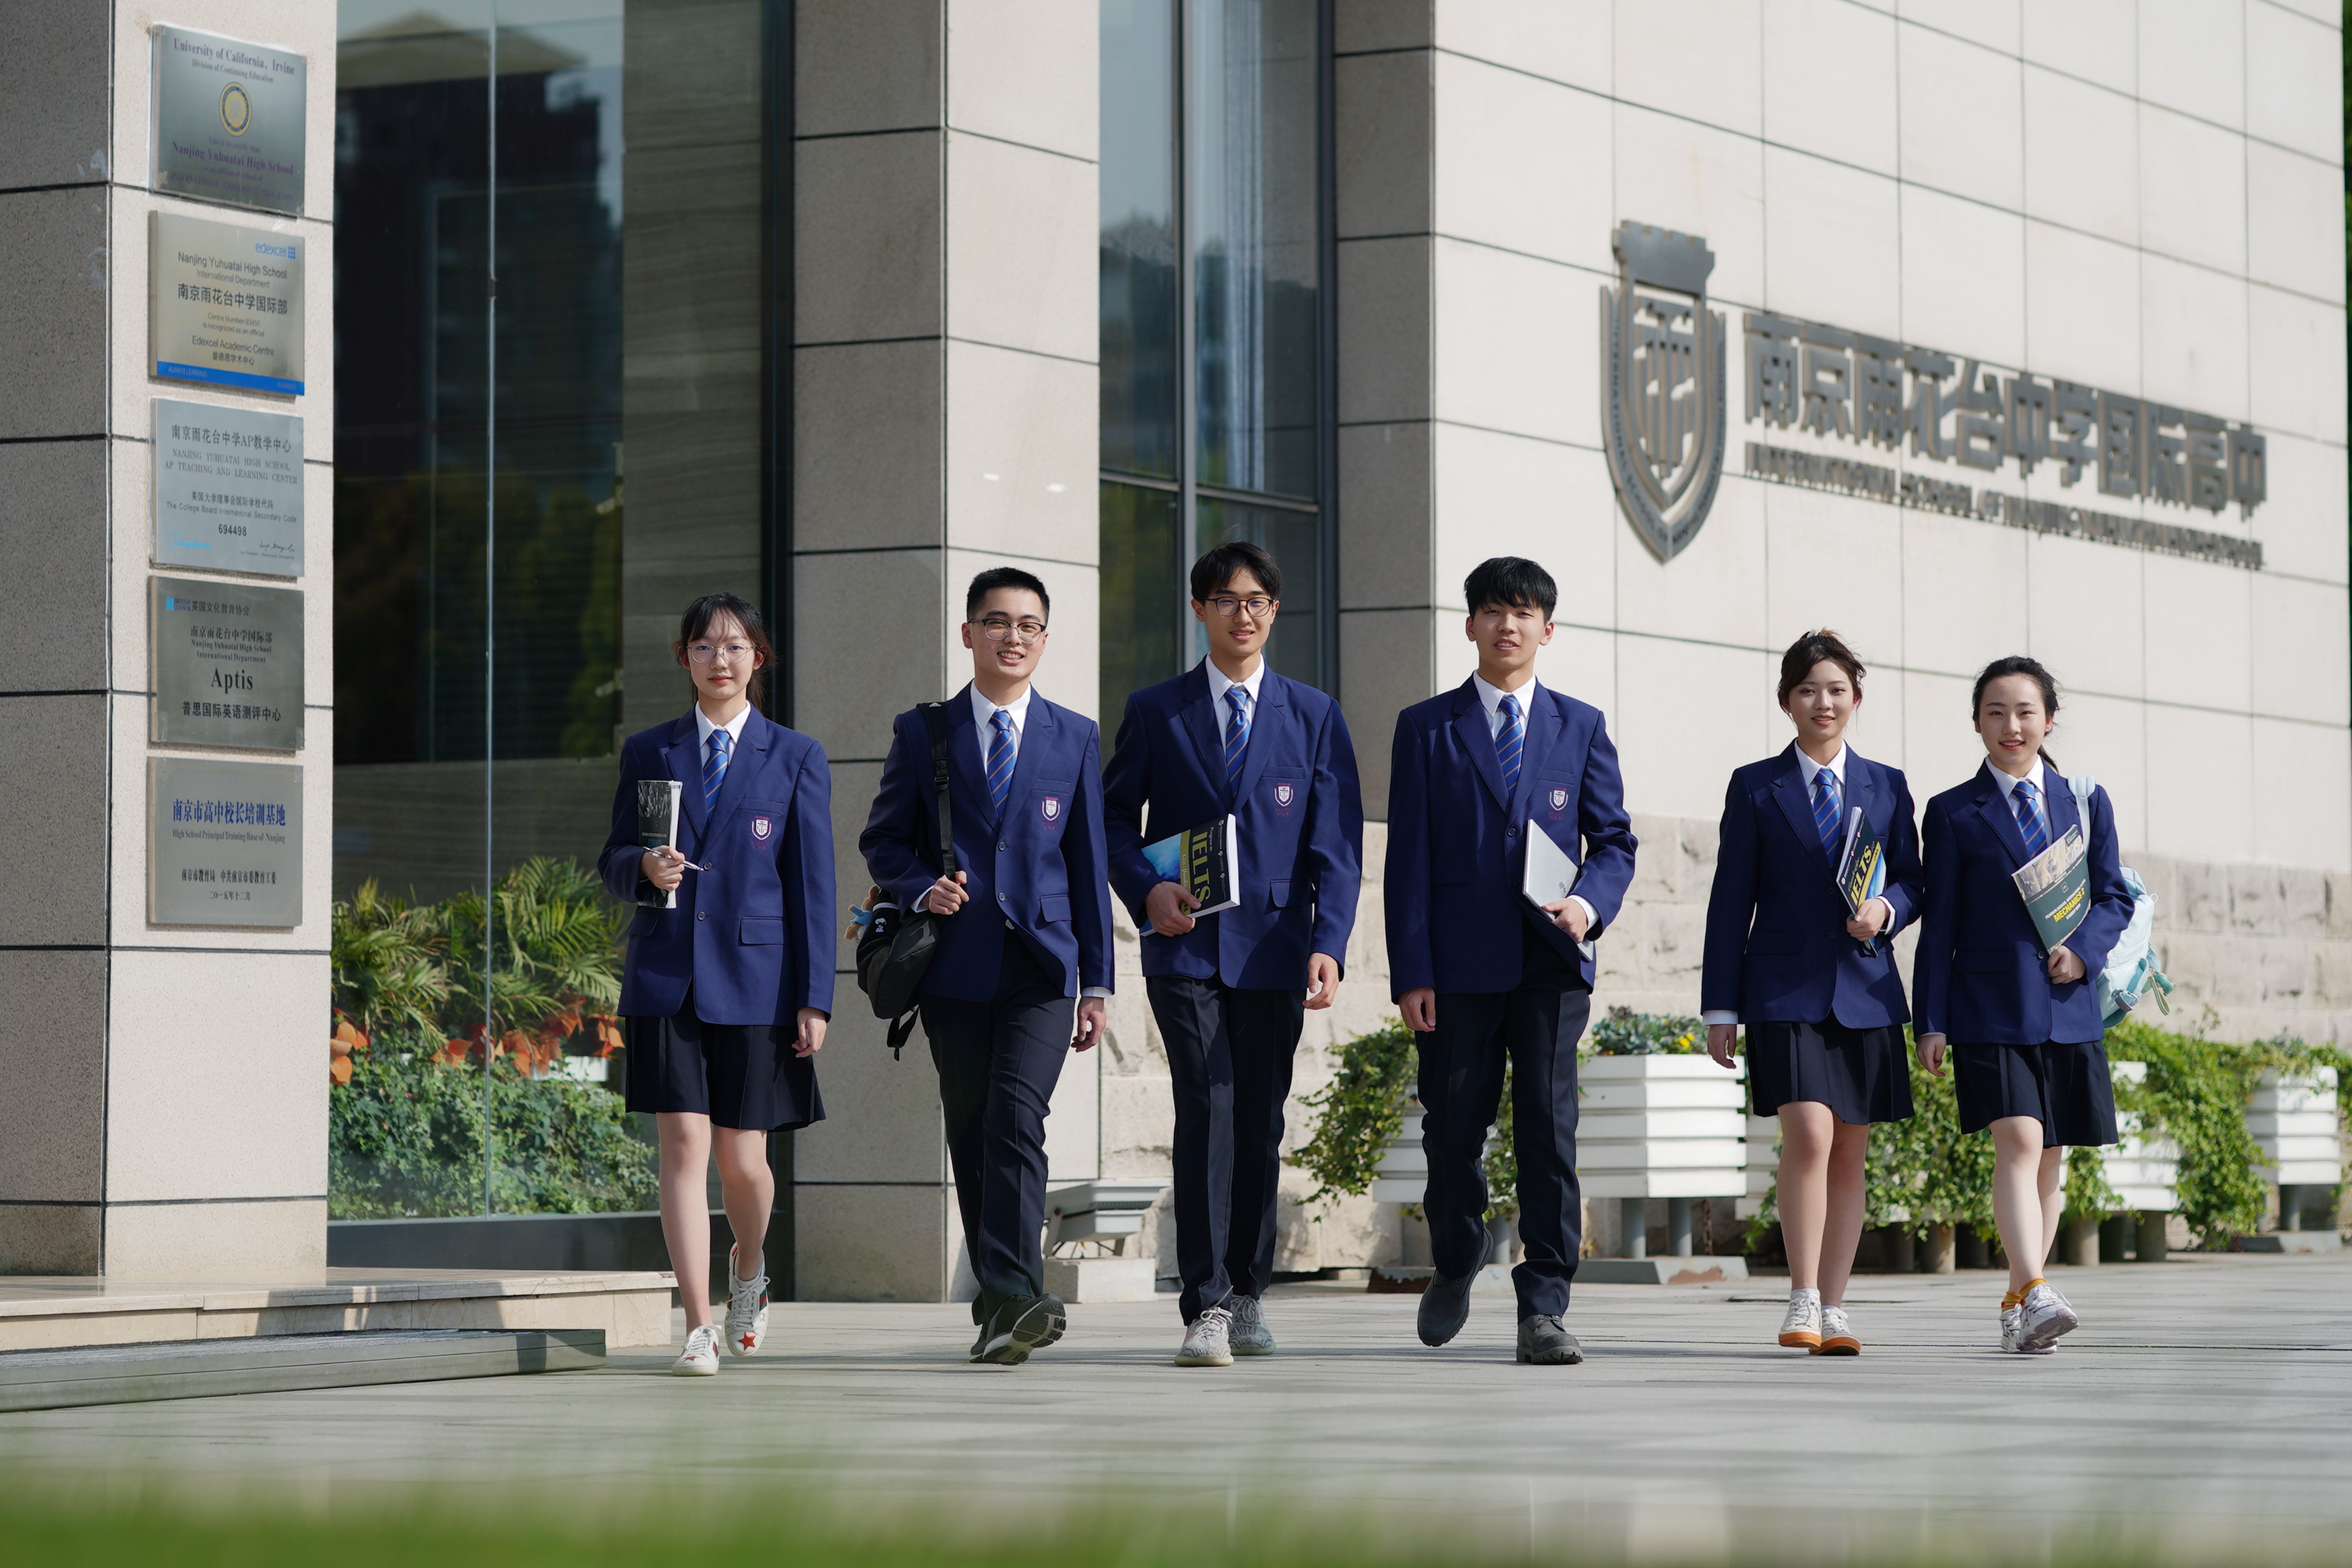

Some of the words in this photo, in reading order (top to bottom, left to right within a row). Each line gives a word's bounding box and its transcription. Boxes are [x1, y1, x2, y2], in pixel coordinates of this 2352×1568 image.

[174, 38, 213, 60] University
[216, 48, 224, 59] of
[272, 60, 295, 75] Irvine
[192, 59, 212, 71] Division
[213, 63, 219, 72] of
[220, 65, 248, 79] Continuing
[249, 71, 274, 84] Education
[173, 141, 205, 160] Nanjing
[209, 148, 244, 166] Yuhuatai
[247, 155, 265, 171] High
[268, 160, 293, 176] School
[255, 243, 287, 257] edexcel
[178, 251, 207, 268] Nanjing
[209, 256, 243, 271] Yuhuatai
[244, 262, 261, 277] High
[262, 265, 287, 280] School
[197, 268, 234, 283] International
[235, 275, 270, 289] Department
[178, 283, 287, 316] 南京雨花台中学国际部
[207, 312, 224, 322] Centre
[192, 335, 218, 348] Edexcel
[220, 339, 252, 353] Academic
[253, 345, 275, 357] Centre
[171, 424, 291, 453] 南京雨花台中学AP教学中心
[172, 448, 202, 460] NANJING
[206, 452, 240, 466] YUHUATAI
[244, 457, 261, 468] HIGH
[265, 460, 290, 471] SCHOOL
[164, 461, 174, 469] AP
[177, 462, 212, 474] TEACHING
[216, 467, 230, 476] AND
[235, 468, 268, 481] LEARNING
[272, 473, 298, 485] CENTER
[1745, 442, 1895, 504] INTERNATIONAL
[1901, 471, 1973, 519] SCHOOL
[167, 501, 176, 510] The
[179, 503, 199, 513] College
[201, 505, 217, 514] Board
[219, 509, 252, 517] International
[254, 510, 281, 522] Secondary
[283, 514, 297, 523] Code
[218, 523, 247, 537] 694498
[191, 601, 250, 616] 英国文化教育协会
[191, 625, 272, 644] 南京雨花台中学国际部
[191, 639, 213, 650] Nanjing
[214, 642, 238, 650] Yuhuatai
[239, 643, 252, 653] High
[253, 644, 271, 653] School
[197, 650, 232, 660] International
[234, 653, 266, 664] Department
[211, 667, 253, 694] Aptis
[182, 701, 281, 721] 普思国际英语测评中心
[173, 798, 286, 826] 南京市高中校长培训基地
[173, 829, 185, 840] High
[185, 830, 201, 839] School
[202, 831, 225, 841] Principal
[225, 831, 246, 843] Training
[247, 832, 258, 841] Base
[258, 833, 264, 841] of
[266, 833, 285, 844] Nanjing
[181, 868, 215, 883] 南京市教育局
[1192, 832, 1211, 904] IELTS
[1851, 845, 1872, 906] IELTS
[2053, 891, 2082, 922] MECHANICS
[2081, 887, 2085, 896] 2
